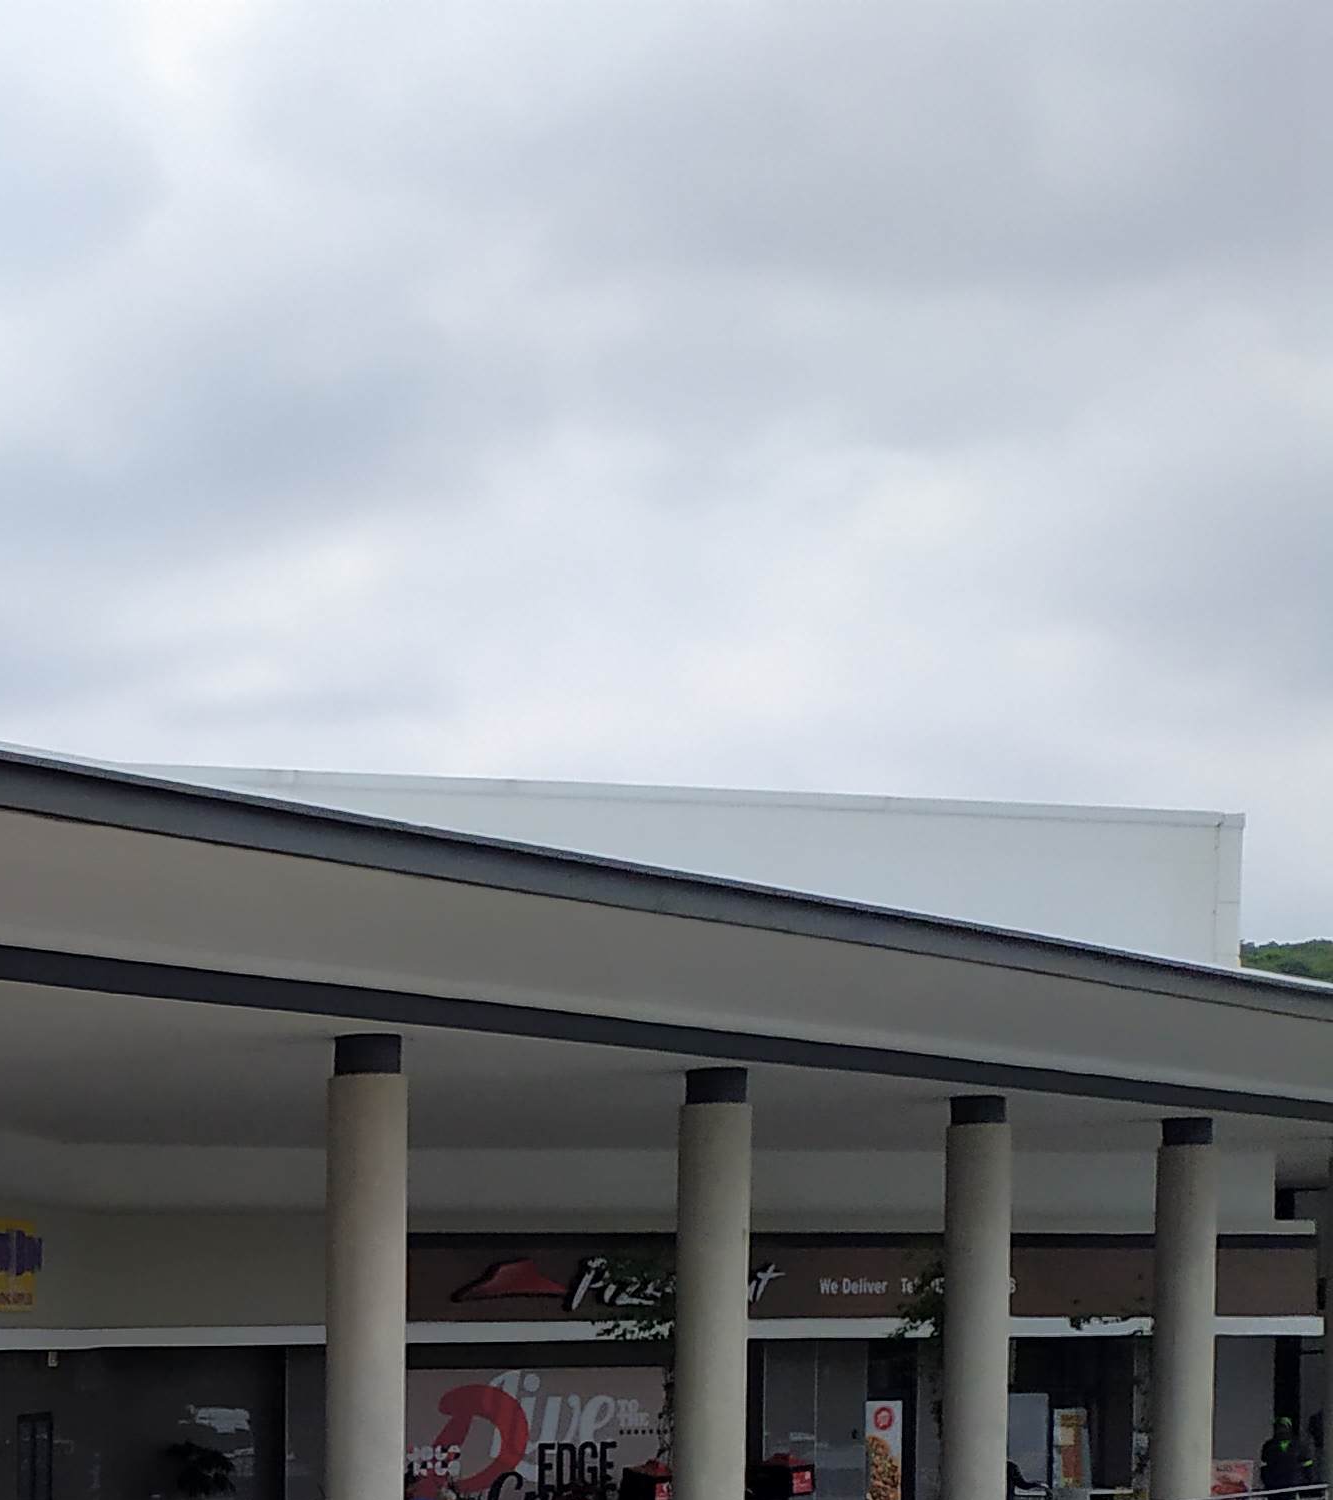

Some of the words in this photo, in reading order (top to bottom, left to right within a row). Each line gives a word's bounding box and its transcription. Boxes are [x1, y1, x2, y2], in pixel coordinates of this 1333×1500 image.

[819, 1277, 838, 1294] We
[842, 1277, 888, 1294] Deliver
[537, 1440, 618, 1494] EDGE
